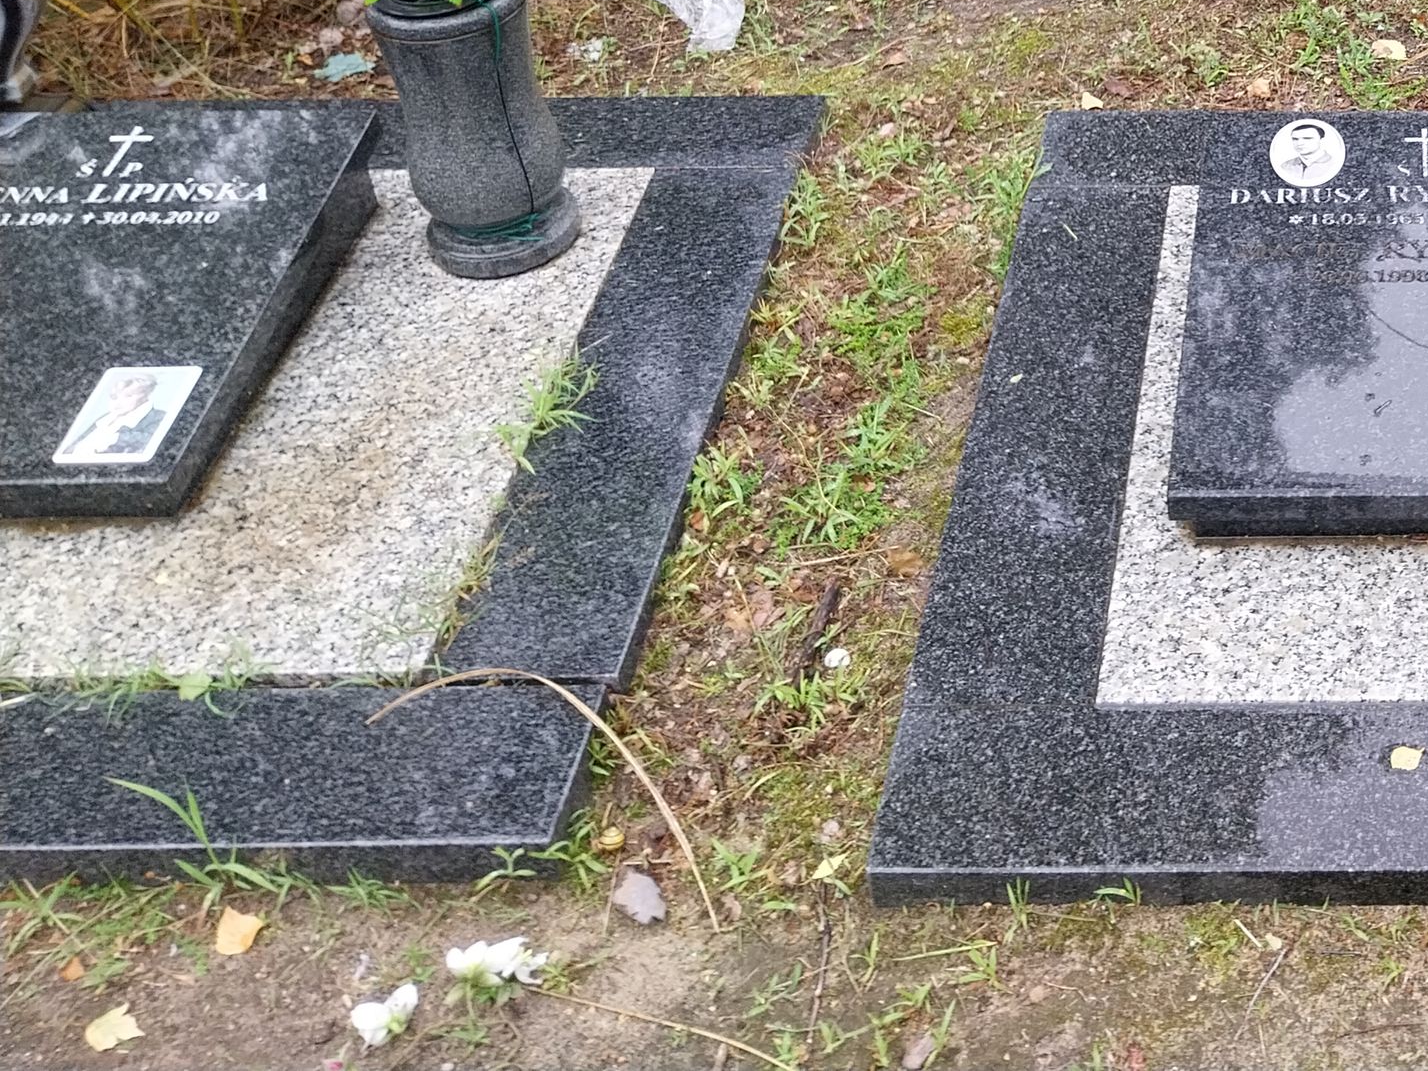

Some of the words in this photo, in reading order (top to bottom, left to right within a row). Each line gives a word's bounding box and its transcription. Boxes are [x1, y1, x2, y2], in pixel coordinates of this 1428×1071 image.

[0, 186, 69, 204] NNA
[81, 178, 267, 204] LIPIŃSKA
[1229, 187, 1371, 205] DARIUSZ
